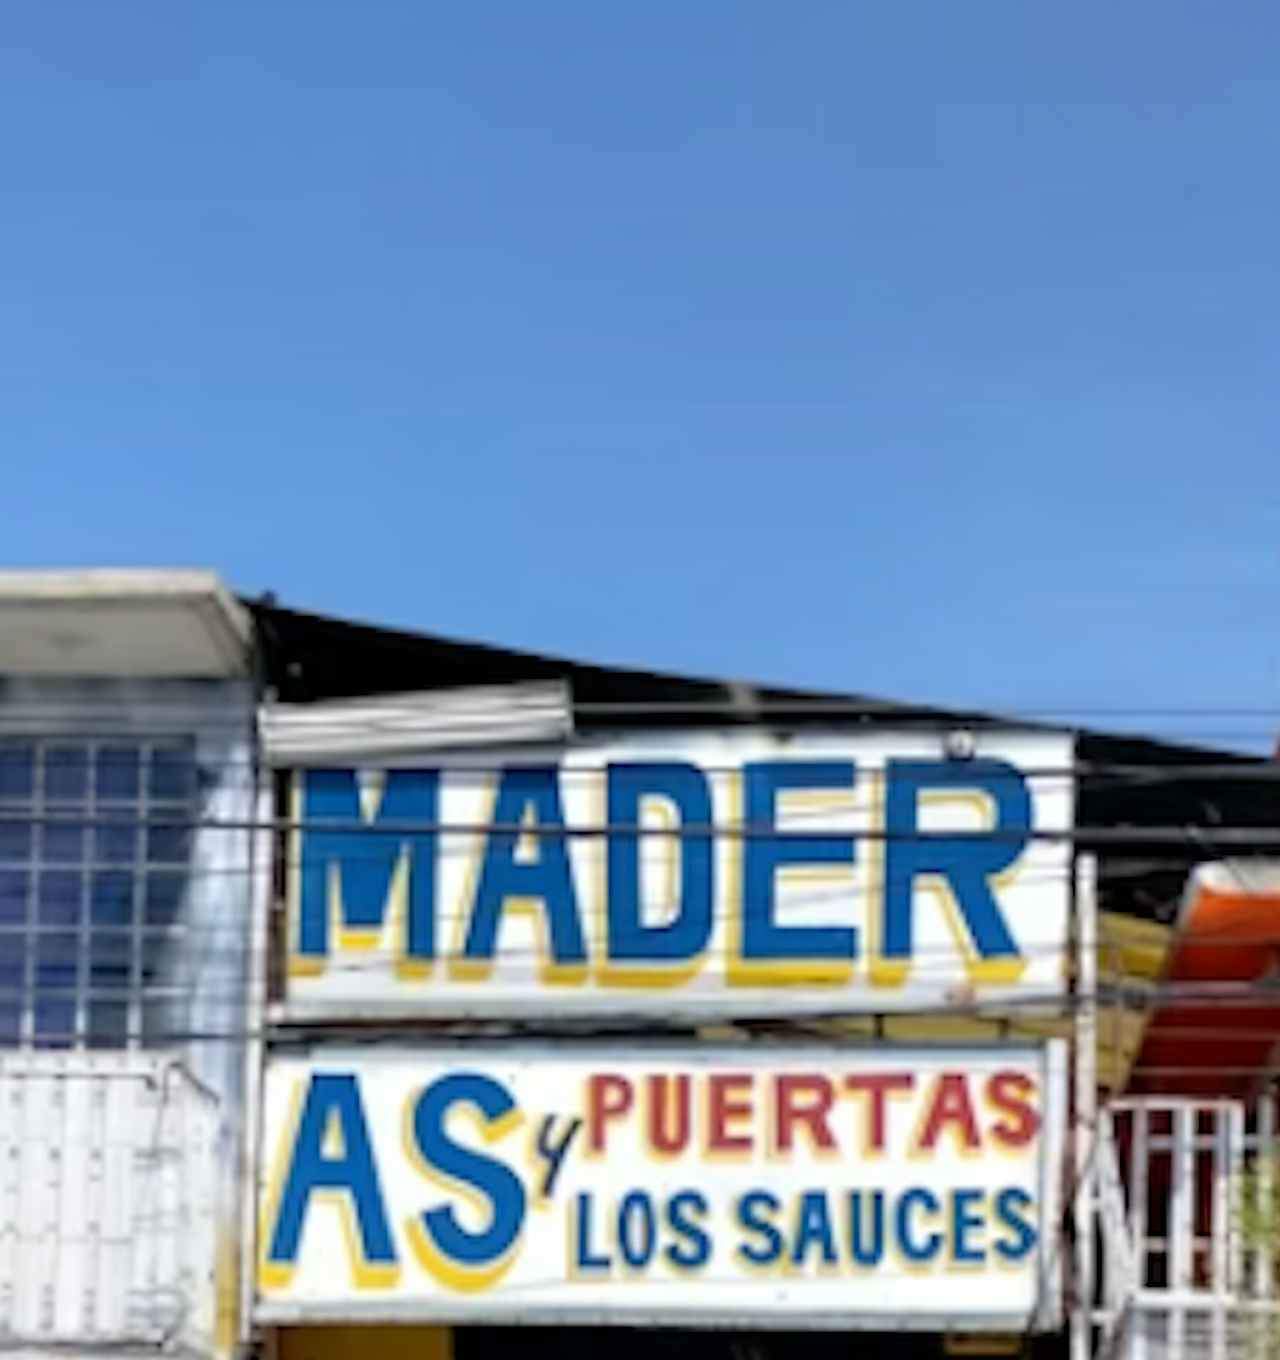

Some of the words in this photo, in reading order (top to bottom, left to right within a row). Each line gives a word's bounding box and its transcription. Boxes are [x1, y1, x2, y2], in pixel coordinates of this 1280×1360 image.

[290, 756, 1034, 986] MADER
[260, 1070, 527, 1289] AS
[584, 1072, 1042, 1158] PUERTAS
[573, 1187, 712, 1275] LOS
[734, 1187, 1039, 1272] SAUCES
